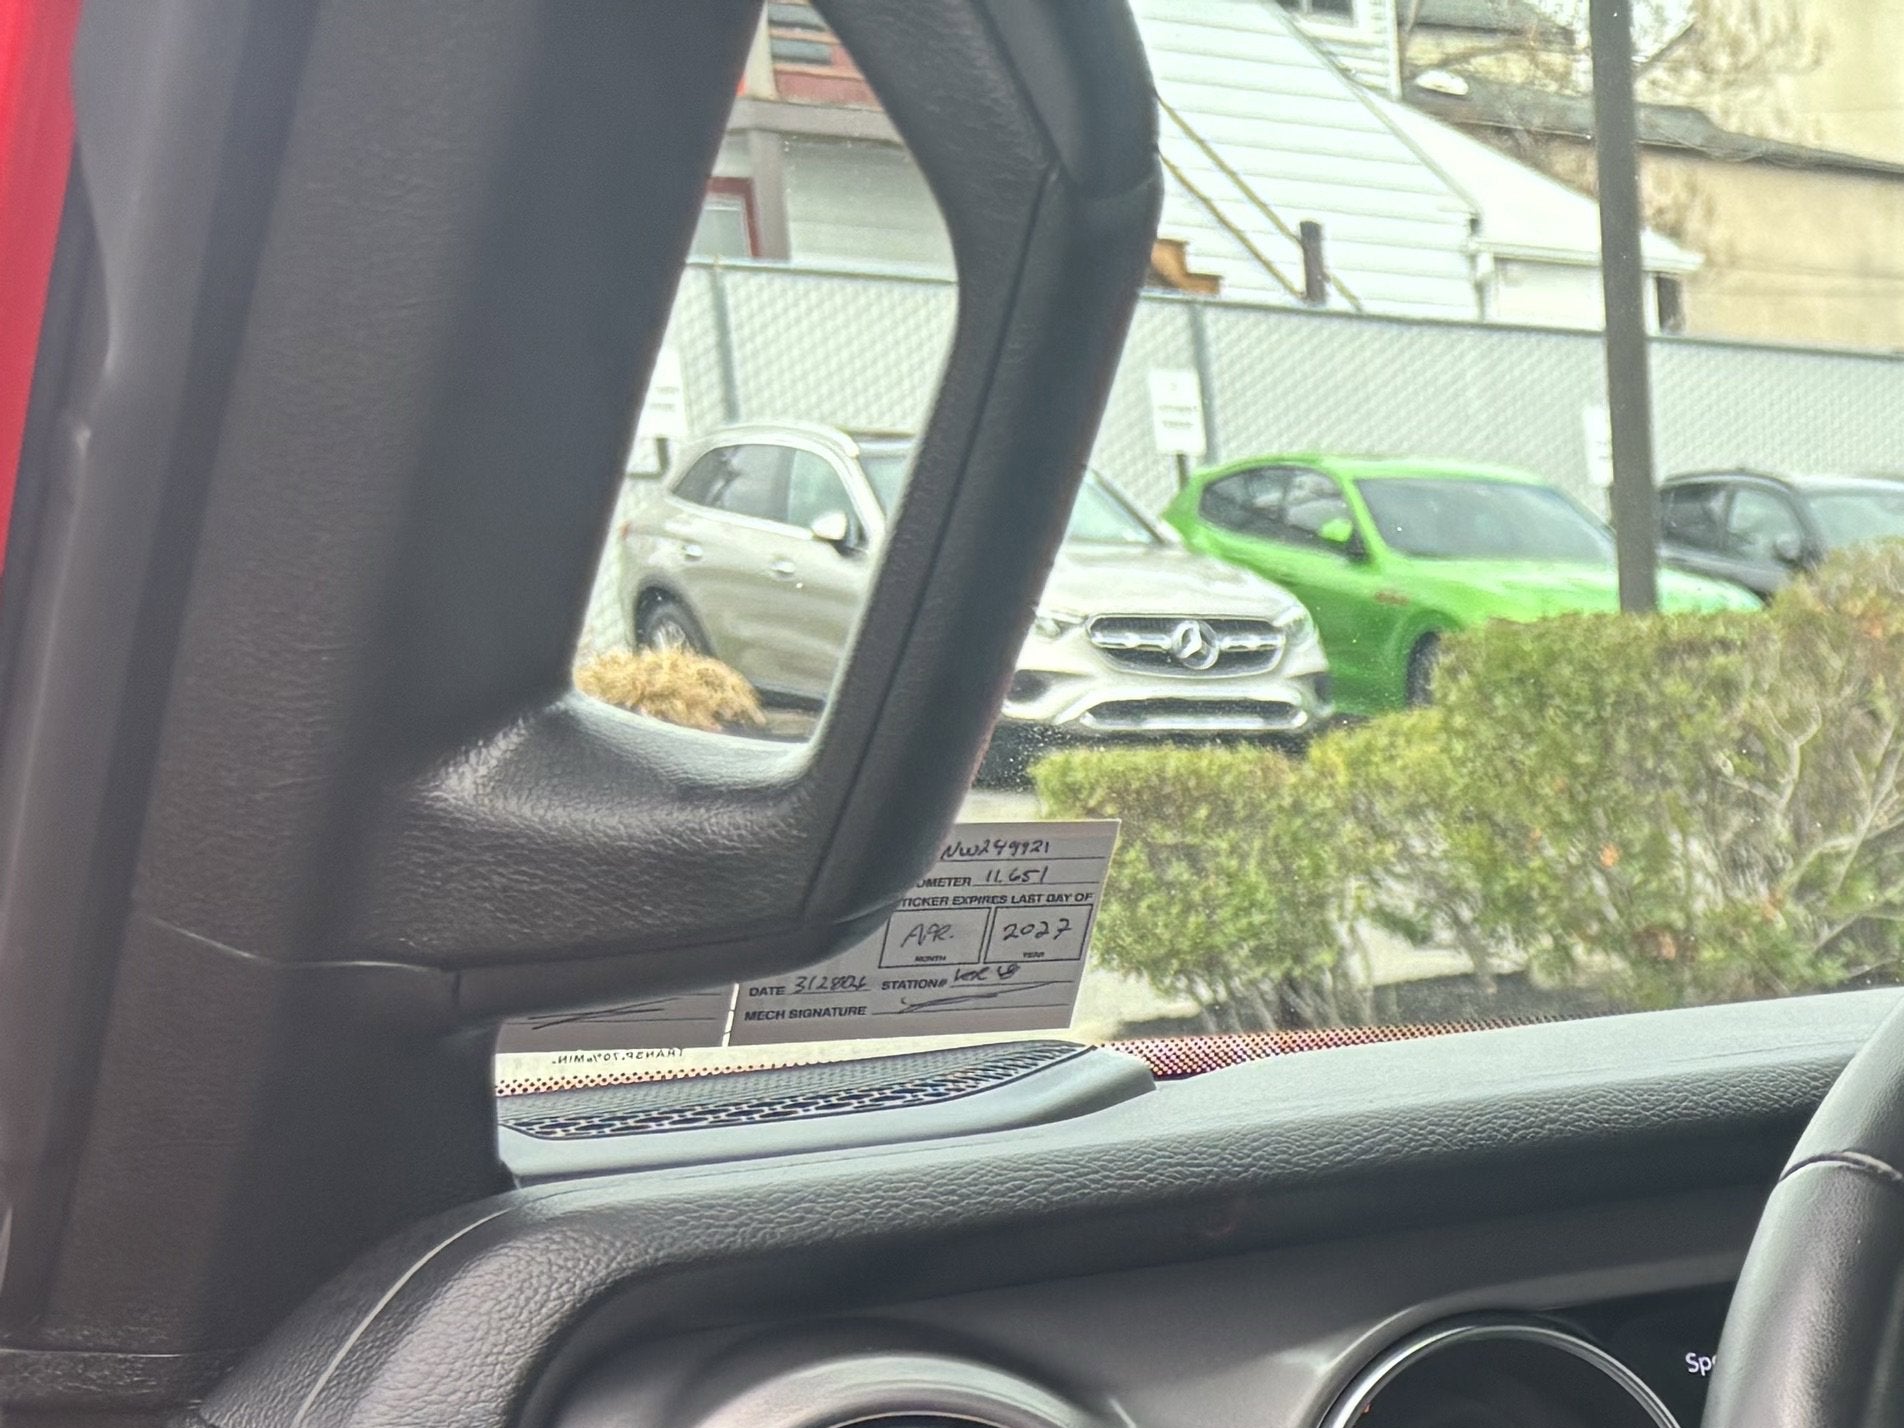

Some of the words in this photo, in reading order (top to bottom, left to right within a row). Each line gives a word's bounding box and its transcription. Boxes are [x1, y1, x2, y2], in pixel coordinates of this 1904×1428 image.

[952, 894, 1007, 905] EXPIRES
[1010, 893, 1044, 904] LAST
[1045, 892, 1073, 903] DAY
[1074, 892, 1093, 901] OF
[749, 986, 785, 997] DATE
[744, 1010, 785, 1021] MECH
[788, 1006, 868, 1019] SIGNATURE
